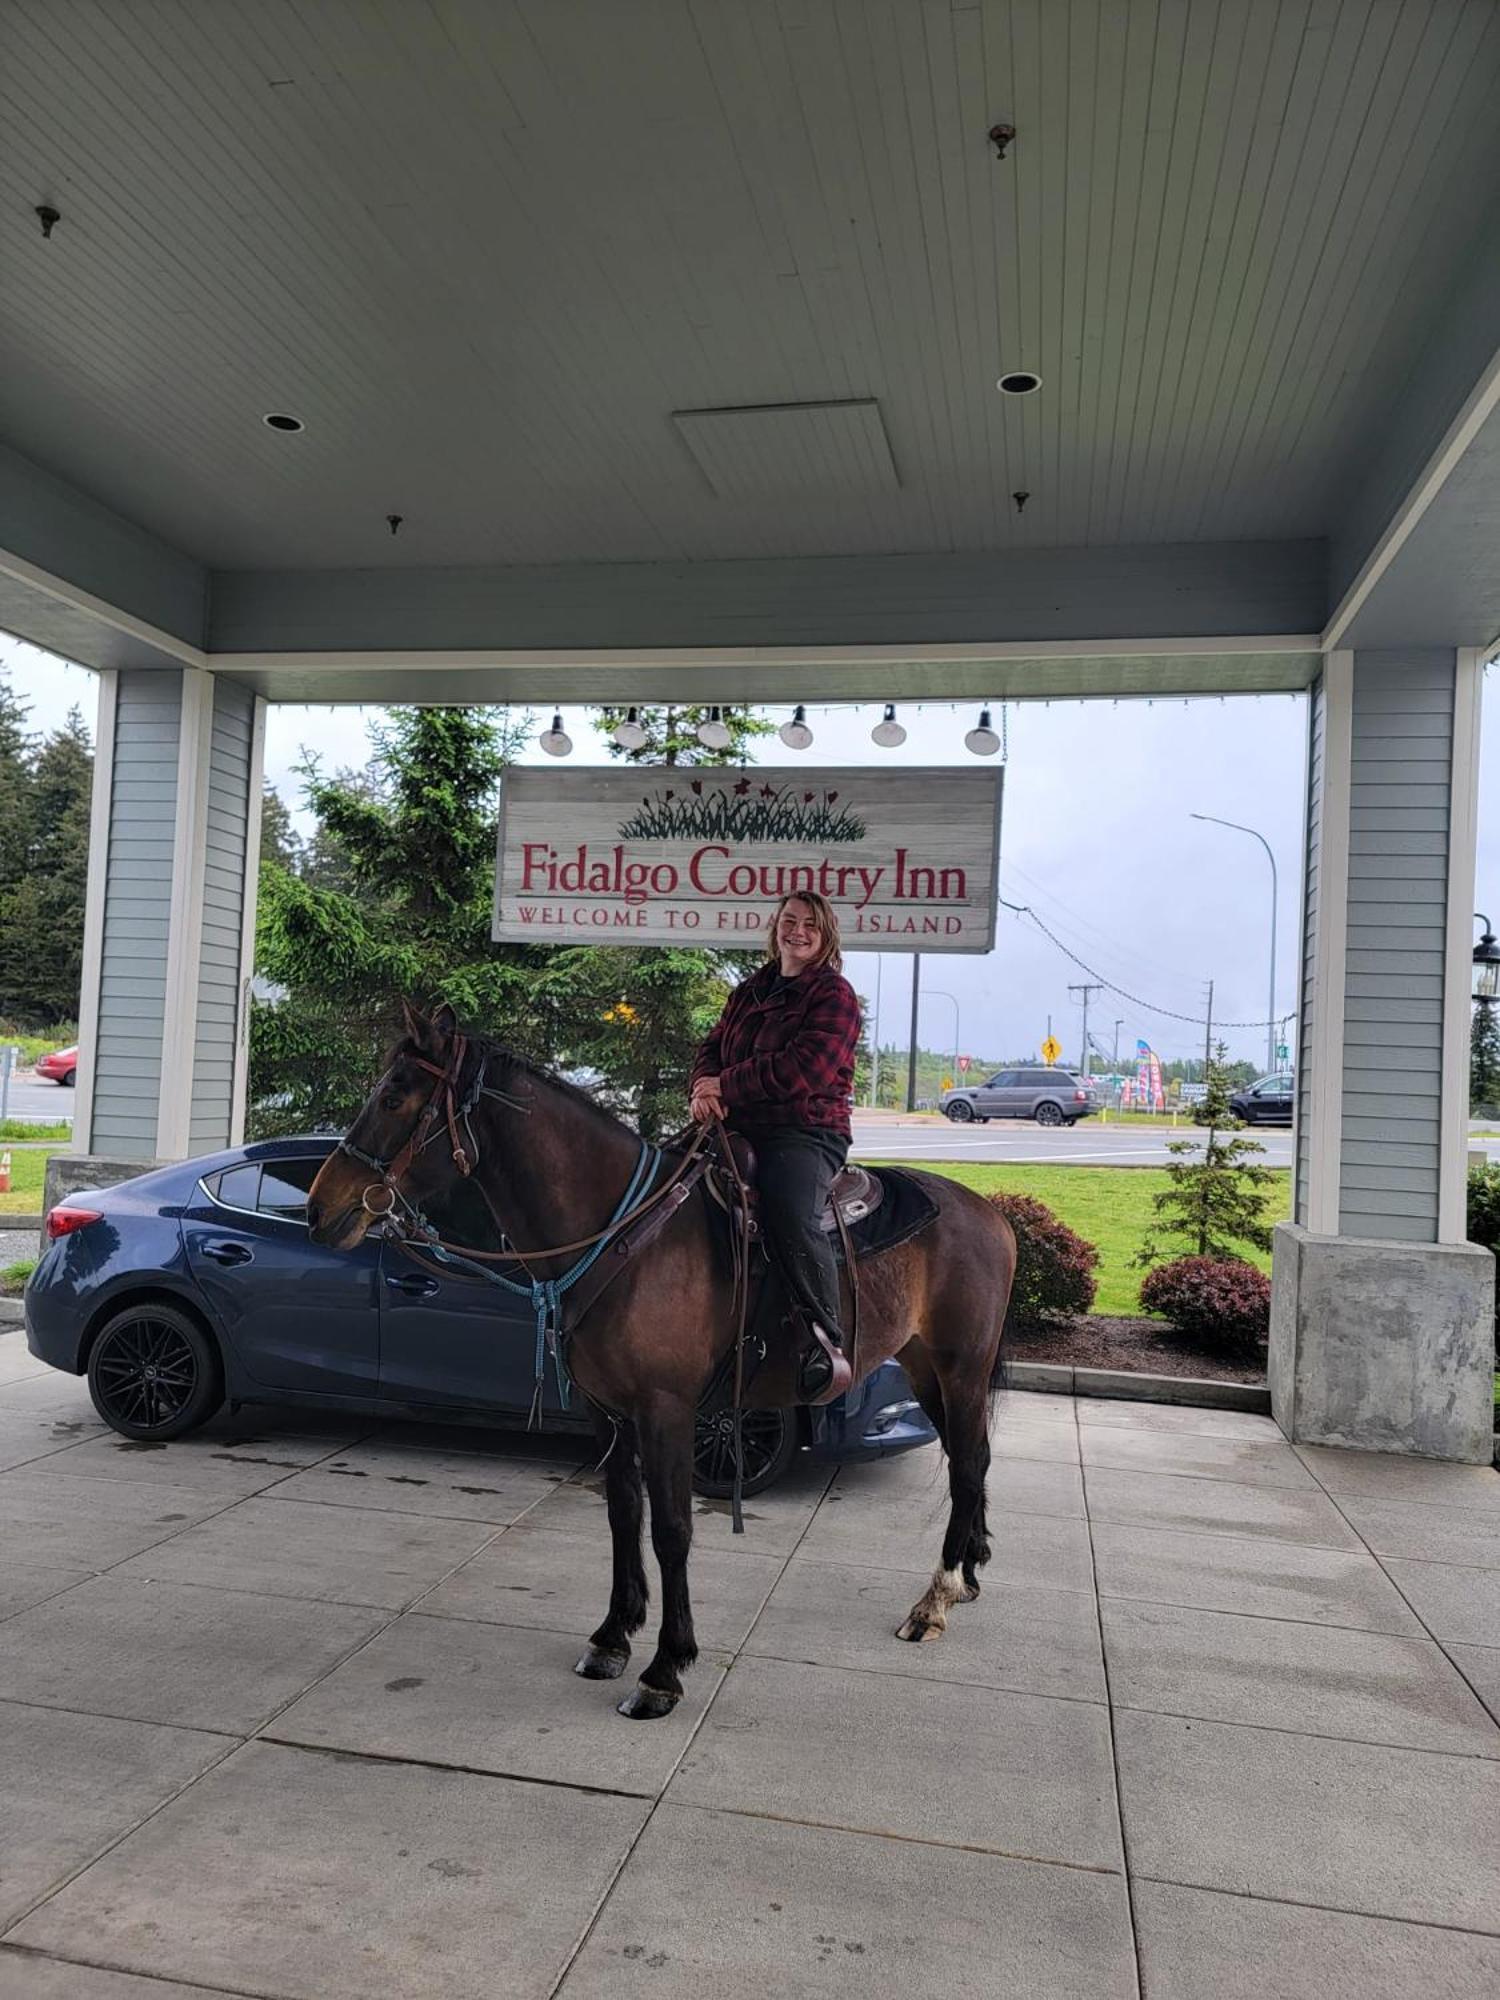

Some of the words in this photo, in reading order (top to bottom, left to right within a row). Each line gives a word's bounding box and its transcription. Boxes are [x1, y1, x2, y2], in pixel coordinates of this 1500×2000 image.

[520, 843, 679, 906] Fidalgo
[688, 845, 886, 909] Country
[893, 848, 968, 899] Inn
[518, 906, 648, 927] WELCOME
[664, 910, 700, 928] TO
[716, 910, 839, 931] FIDA
[857, 914, 963, 935] ISLAND
